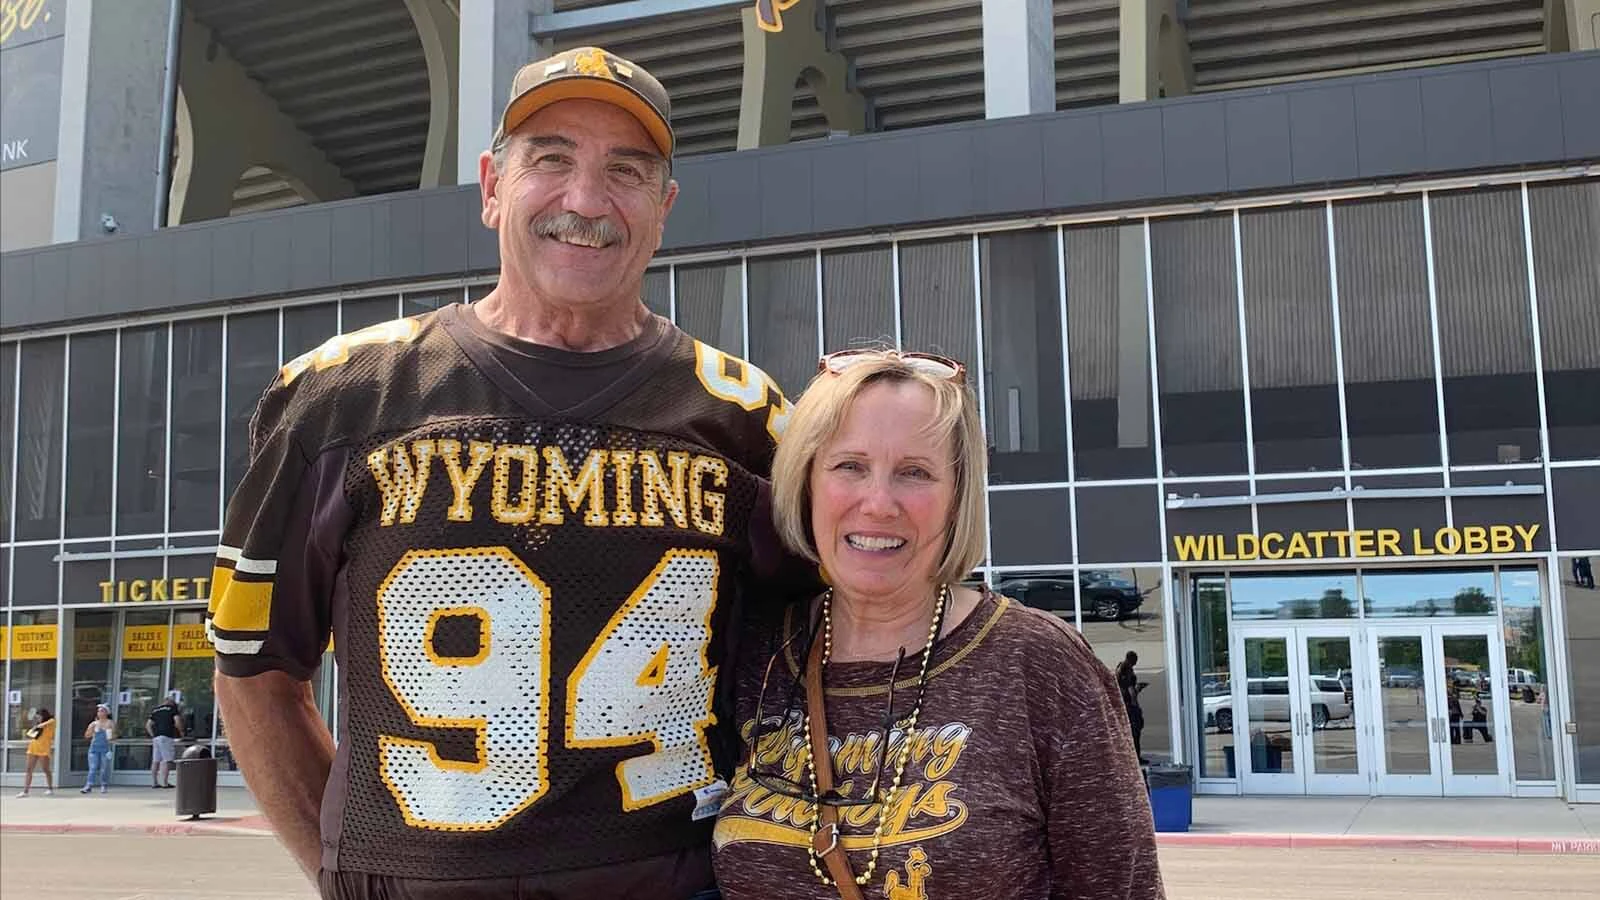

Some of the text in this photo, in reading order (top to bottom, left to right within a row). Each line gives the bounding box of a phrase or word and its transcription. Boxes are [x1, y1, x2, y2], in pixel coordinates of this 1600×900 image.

[367, 438, 729, 537] WYOMING
[1173, 524, 1540, 561] WILDCATTER LOBBY
[17, 632, 53, 641] CUSTOMER
[128, 642, 164, 652] WILL CALL
[132, 632, 155, 641] SALES
[377, 546, 720, 832] 94
